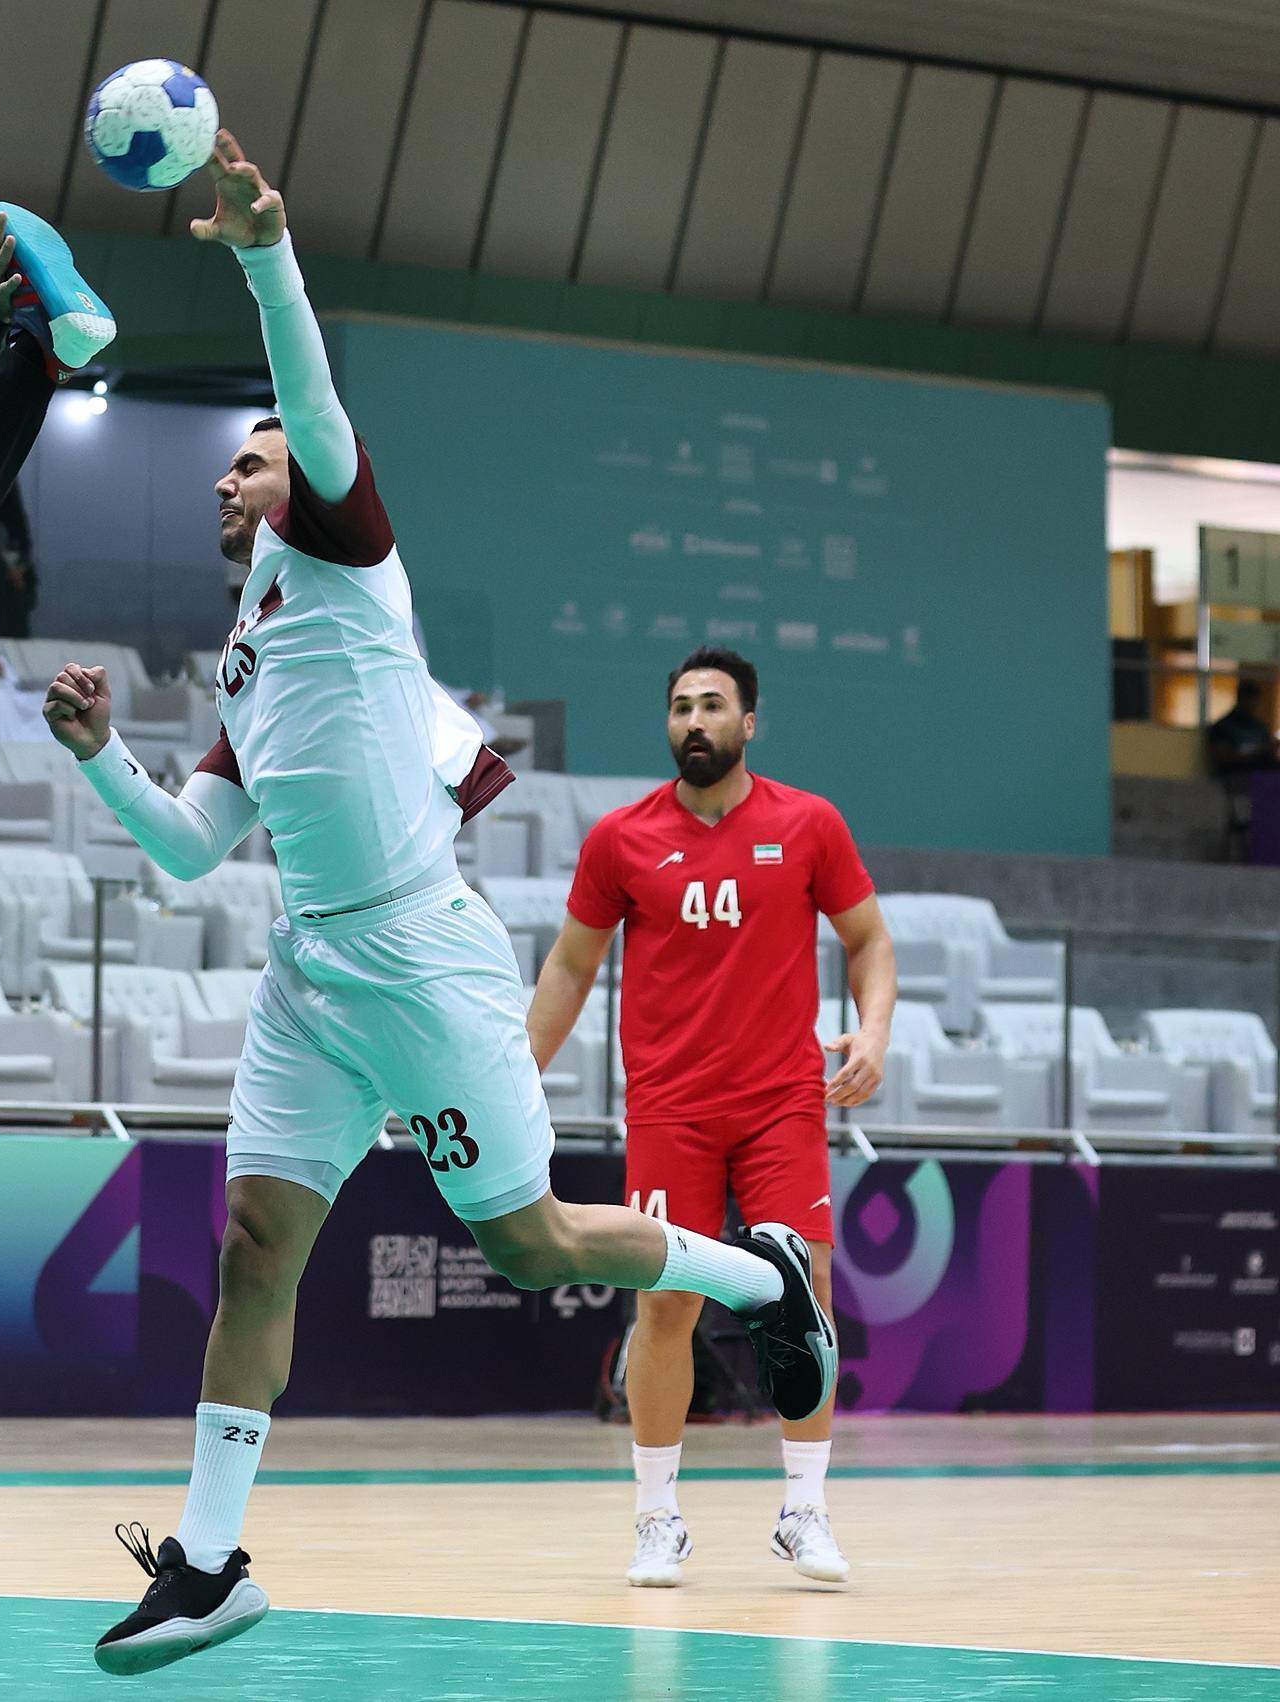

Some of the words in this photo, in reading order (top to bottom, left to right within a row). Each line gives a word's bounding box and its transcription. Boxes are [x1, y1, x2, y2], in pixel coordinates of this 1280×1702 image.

[680, 879, 742, 929] 44
[409, 1107, 480, 1172] 23
[439, 1292, 522, 1308] ASSOCIATION
[222, 1425, 260, 1446] 23
